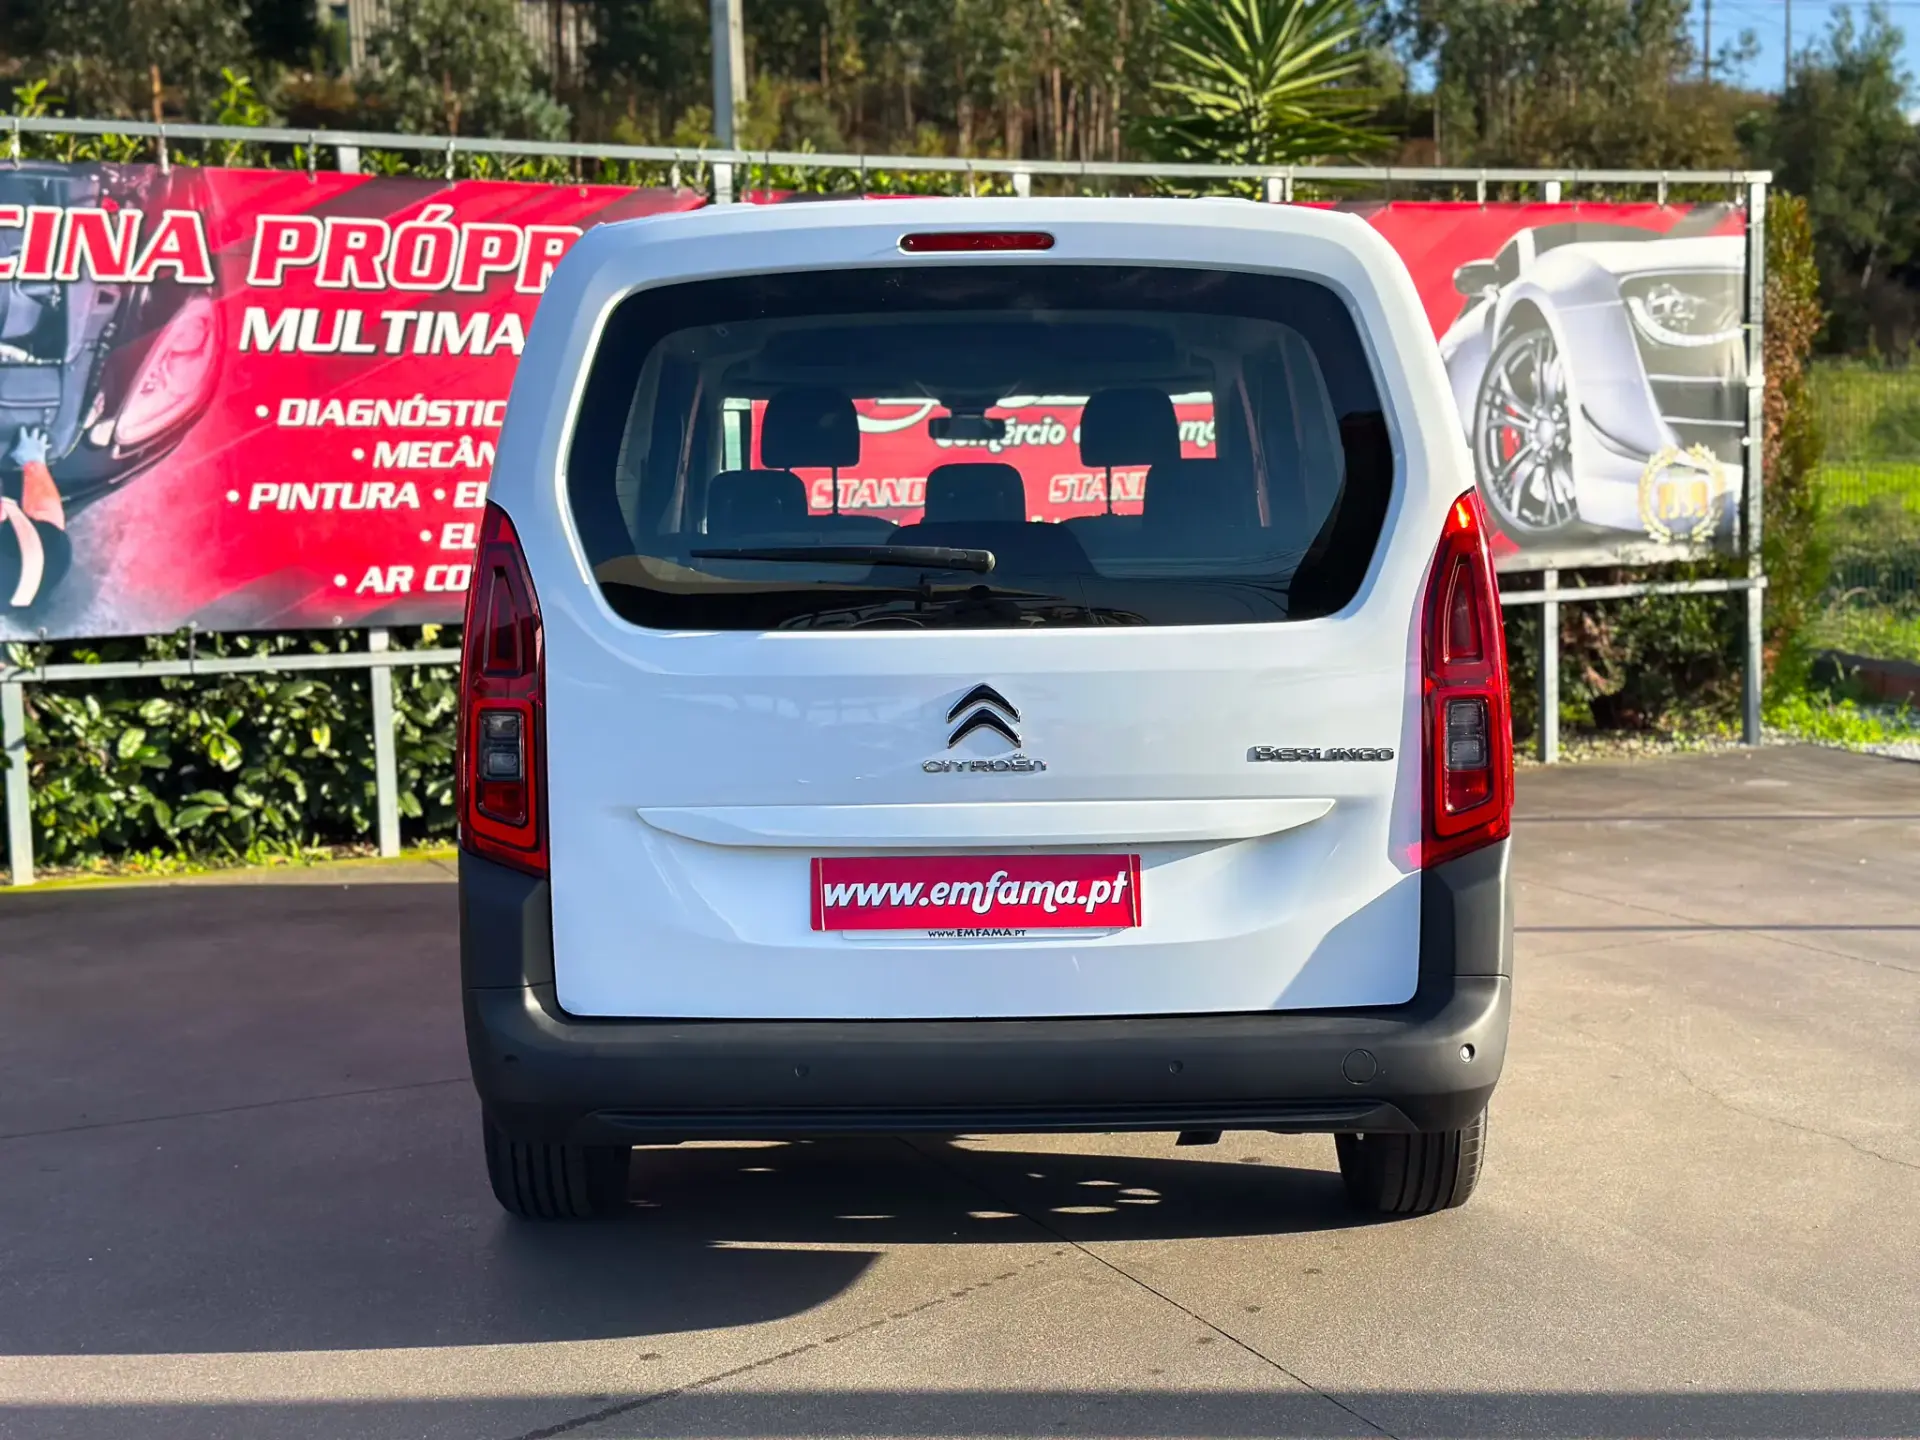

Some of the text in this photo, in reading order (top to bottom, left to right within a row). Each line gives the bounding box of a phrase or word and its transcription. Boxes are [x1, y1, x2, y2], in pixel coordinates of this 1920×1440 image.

[246, 203, 583, 294] PRÓPR
[239, 307, 526, 356] MULTIMA
[278, 394, 508, 428] DIAGNÓSTIC
[248, 481, 419, 510] PINTURA
[355, 564, 473, 594] AR CO
[823, 870, 1128, 914] www.emfama.pt
